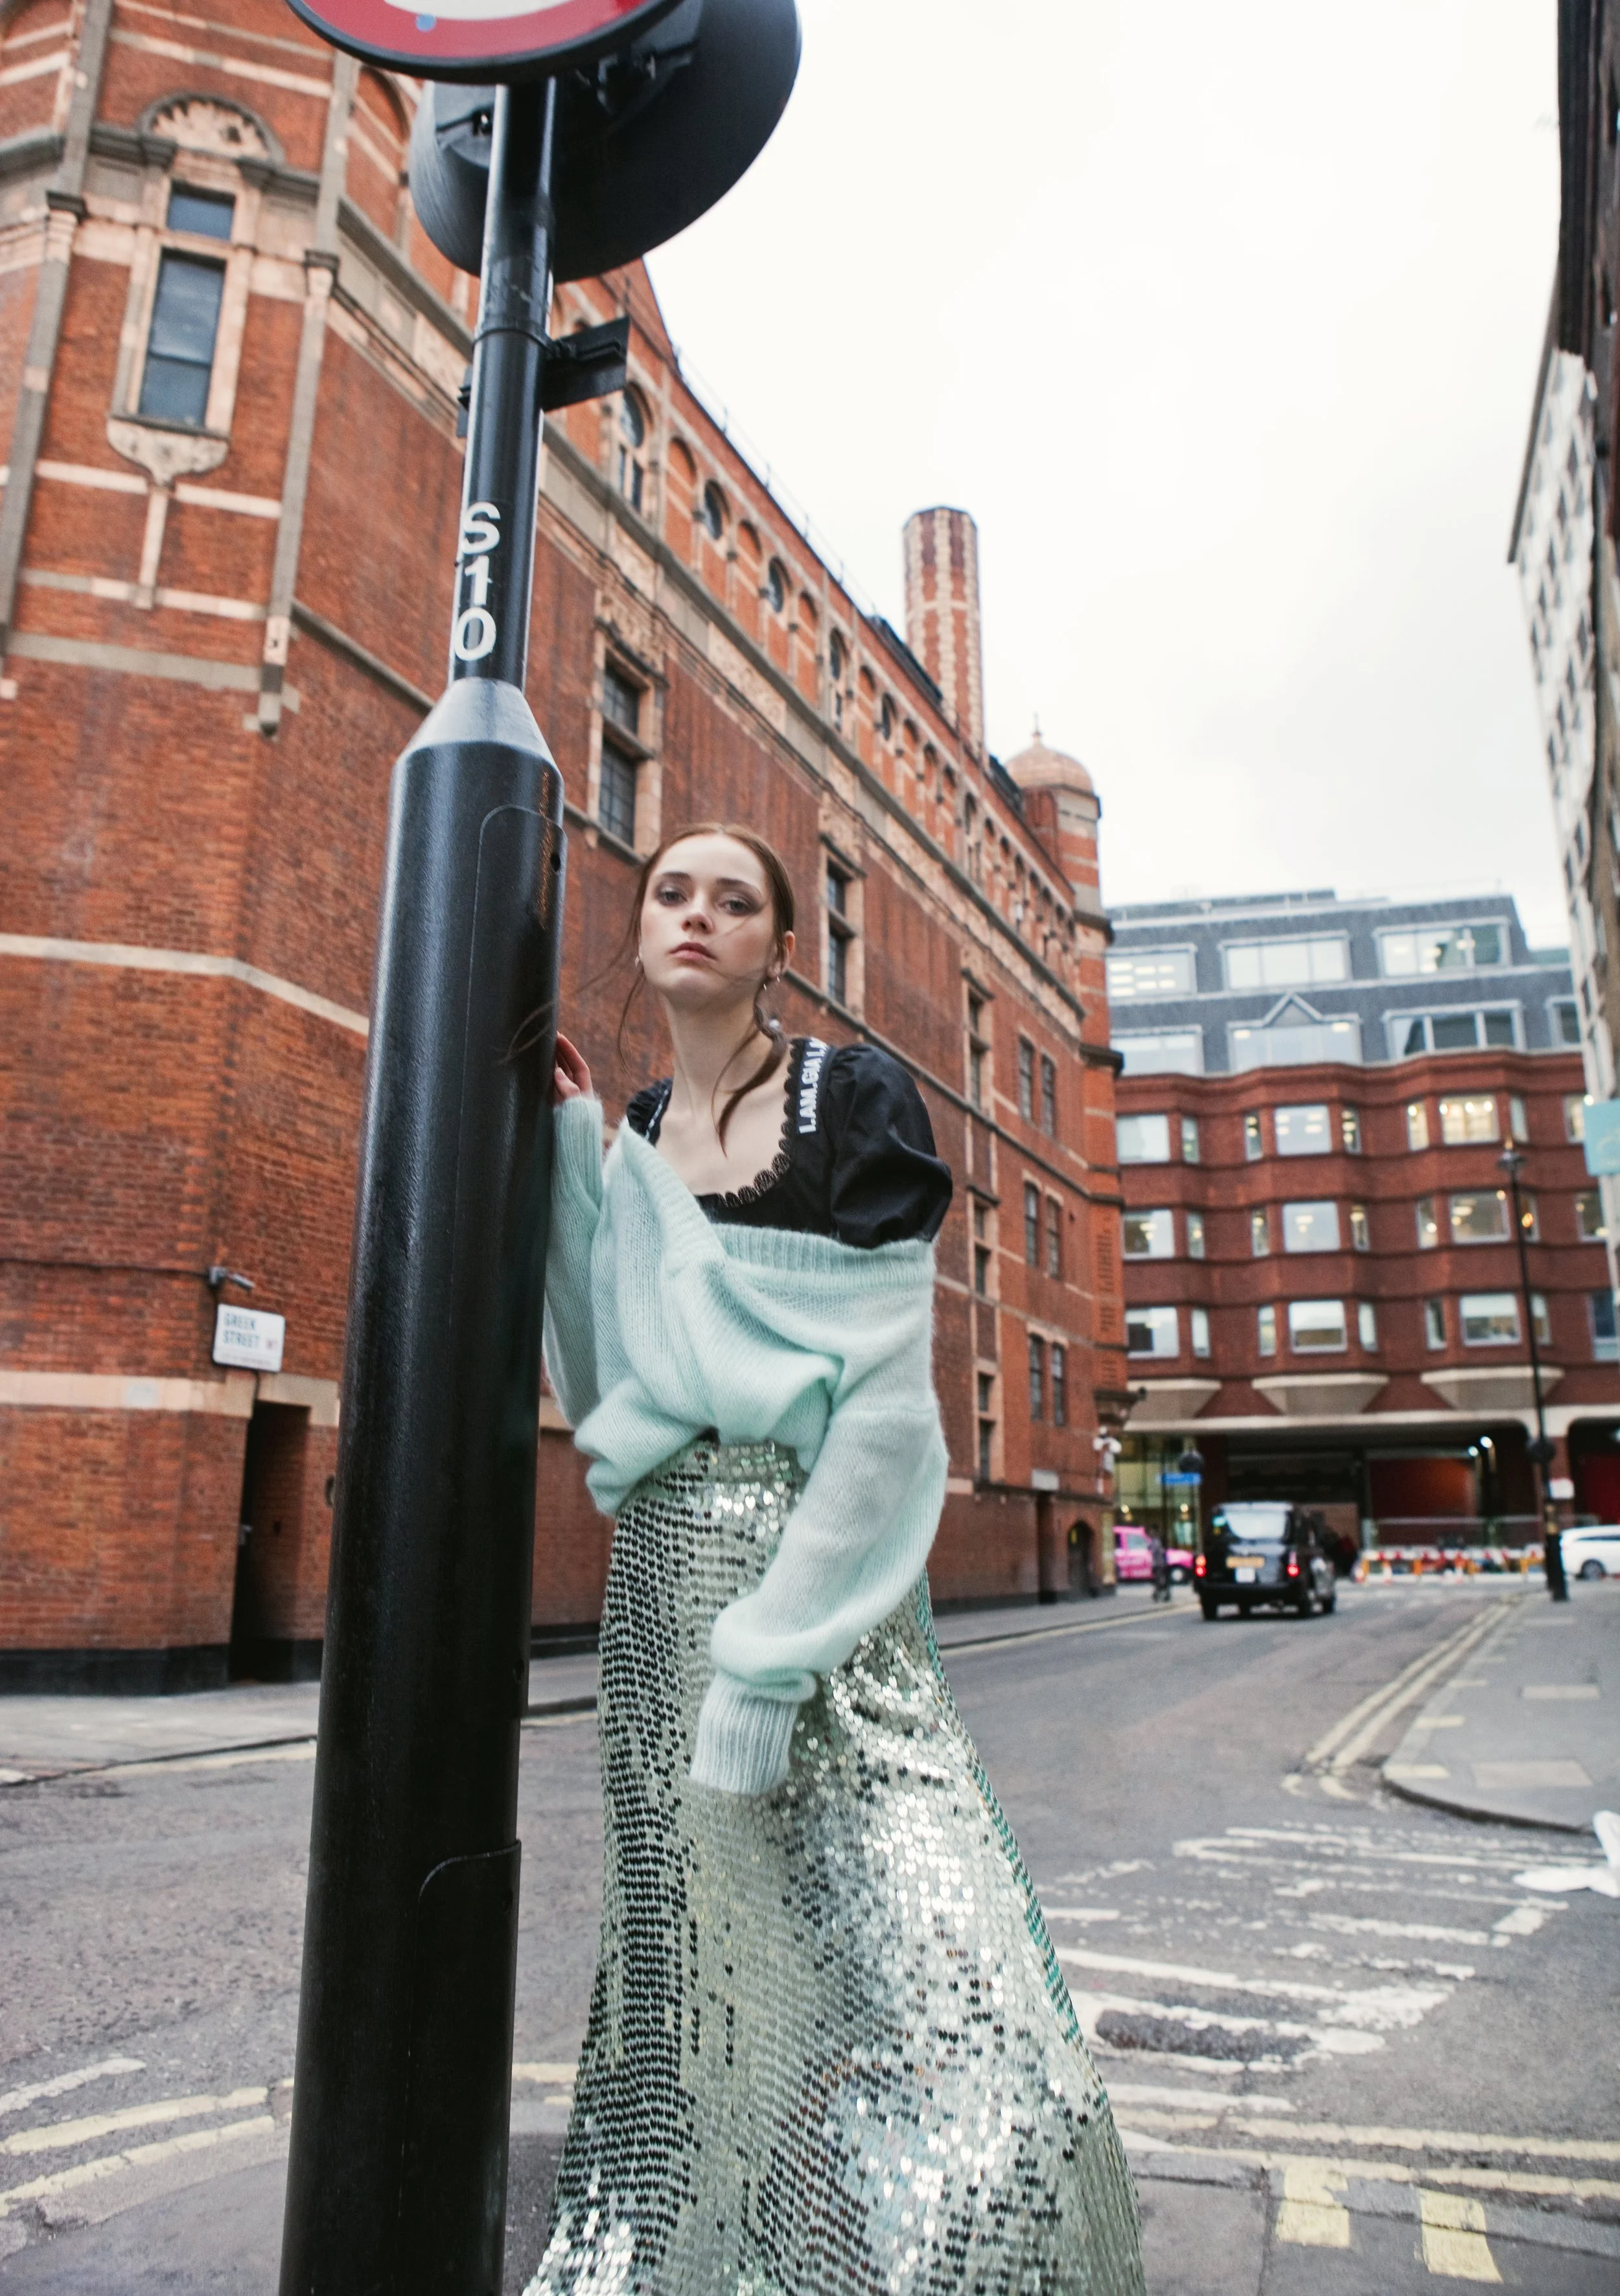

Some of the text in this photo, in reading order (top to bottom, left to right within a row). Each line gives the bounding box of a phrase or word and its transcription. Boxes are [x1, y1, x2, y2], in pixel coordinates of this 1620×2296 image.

[454, 501, 501, 661] S10
[224, 1313, 255, 1330] GREEK
[223, 1330, 259, 1349] STREET
